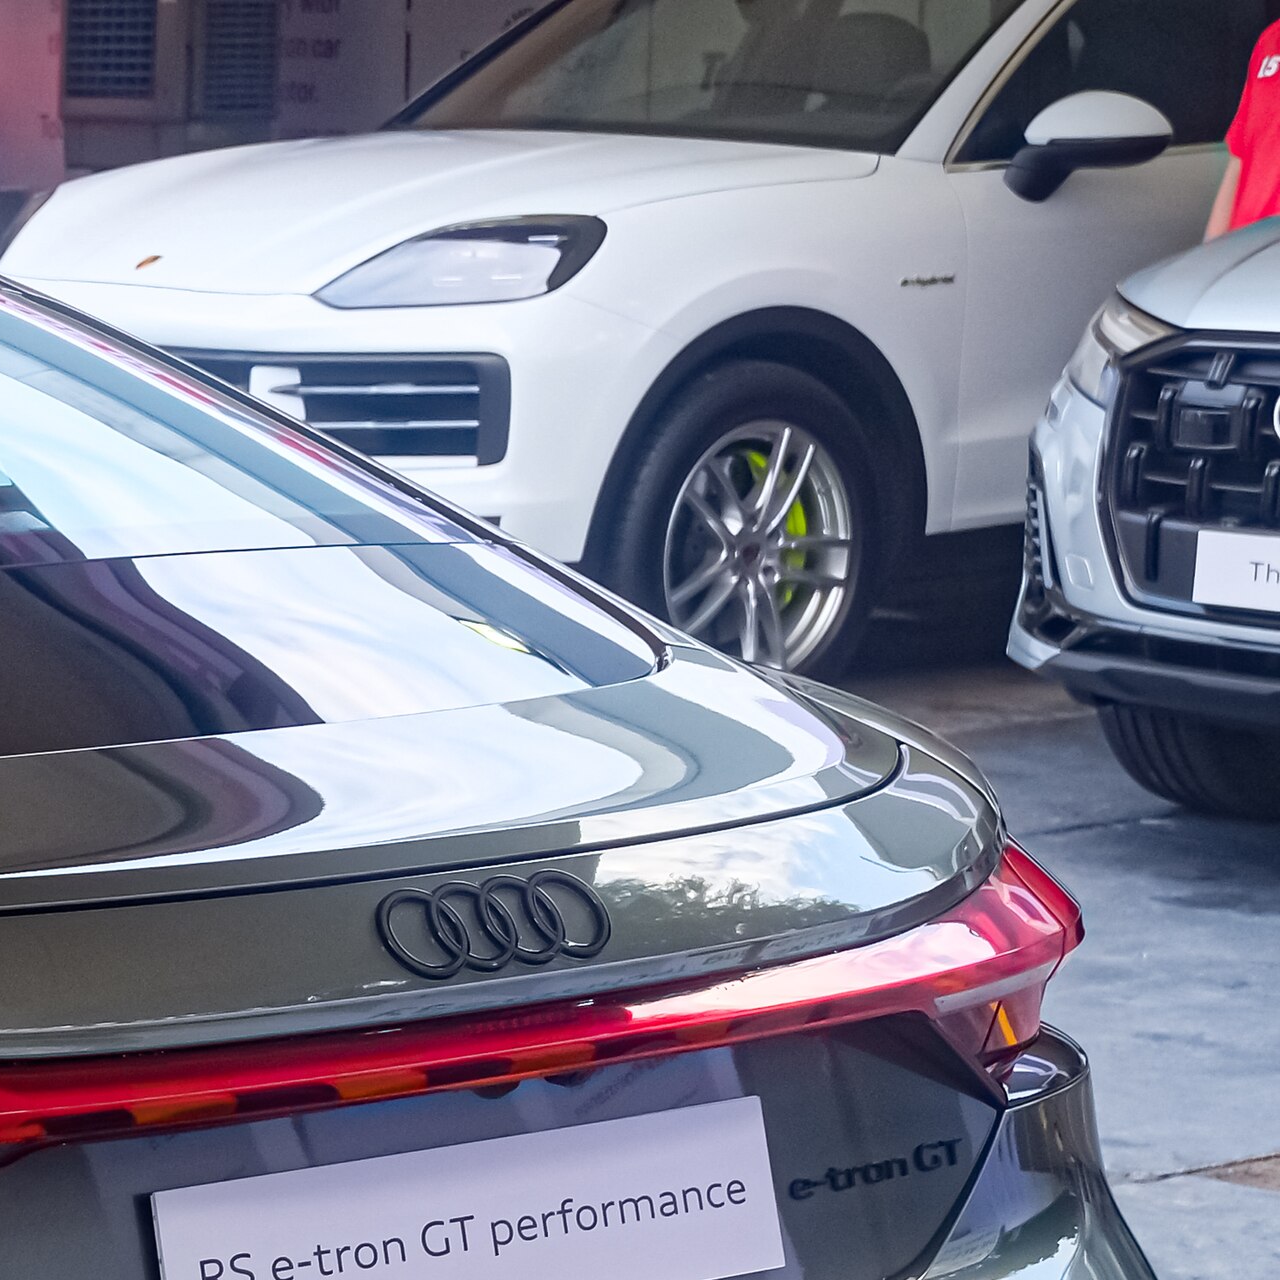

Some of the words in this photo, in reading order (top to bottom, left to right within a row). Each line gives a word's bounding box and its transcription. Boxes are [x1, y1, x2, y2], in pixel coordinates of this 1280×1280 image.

[788, 1157, 910, 1201] e-tron
[912, 1137, 963, 1173] GT
[420, 1214, 476, 1258] GT
[490, 1177, 748, 1257] performance
